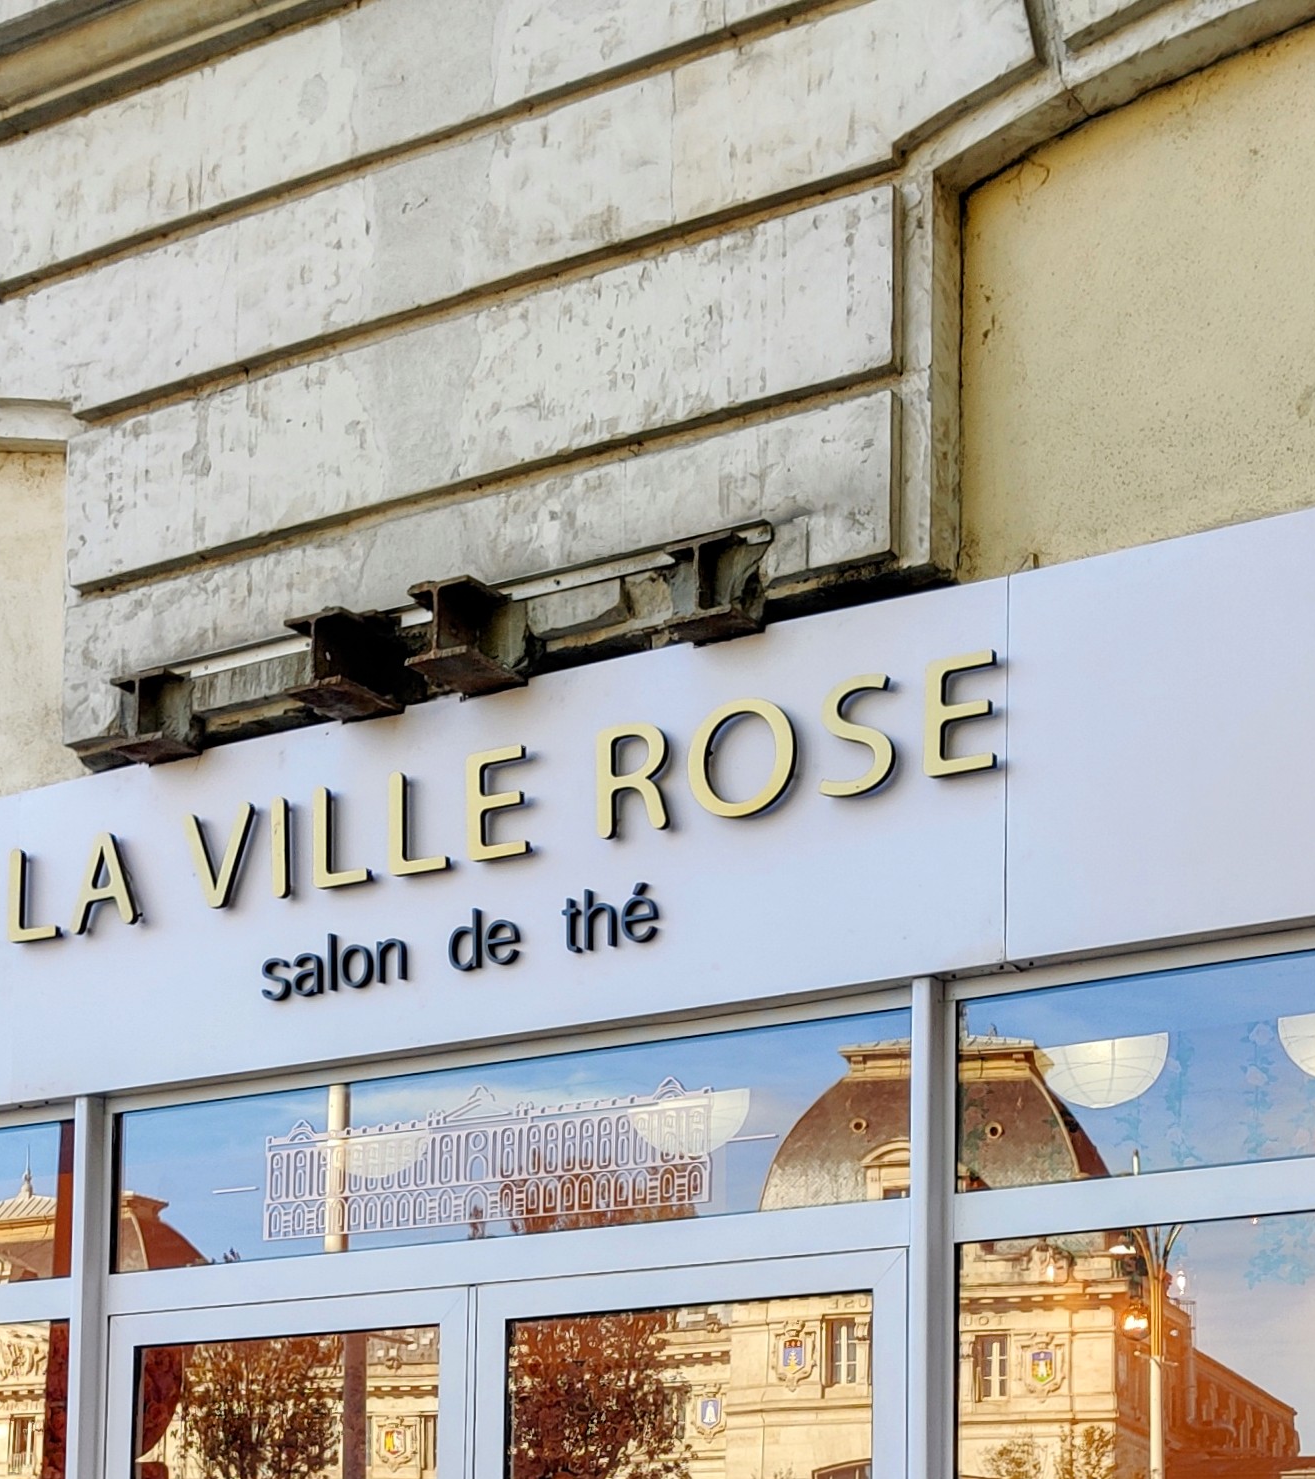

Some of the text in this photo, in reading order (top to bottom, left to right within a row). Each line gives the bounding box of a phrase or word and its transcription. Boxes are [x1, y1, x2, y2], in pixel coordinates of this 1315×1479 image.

[8, 648, 1000, 946] LA VILLE ROSE
[260, 882, 661, 1003] salon de thé
